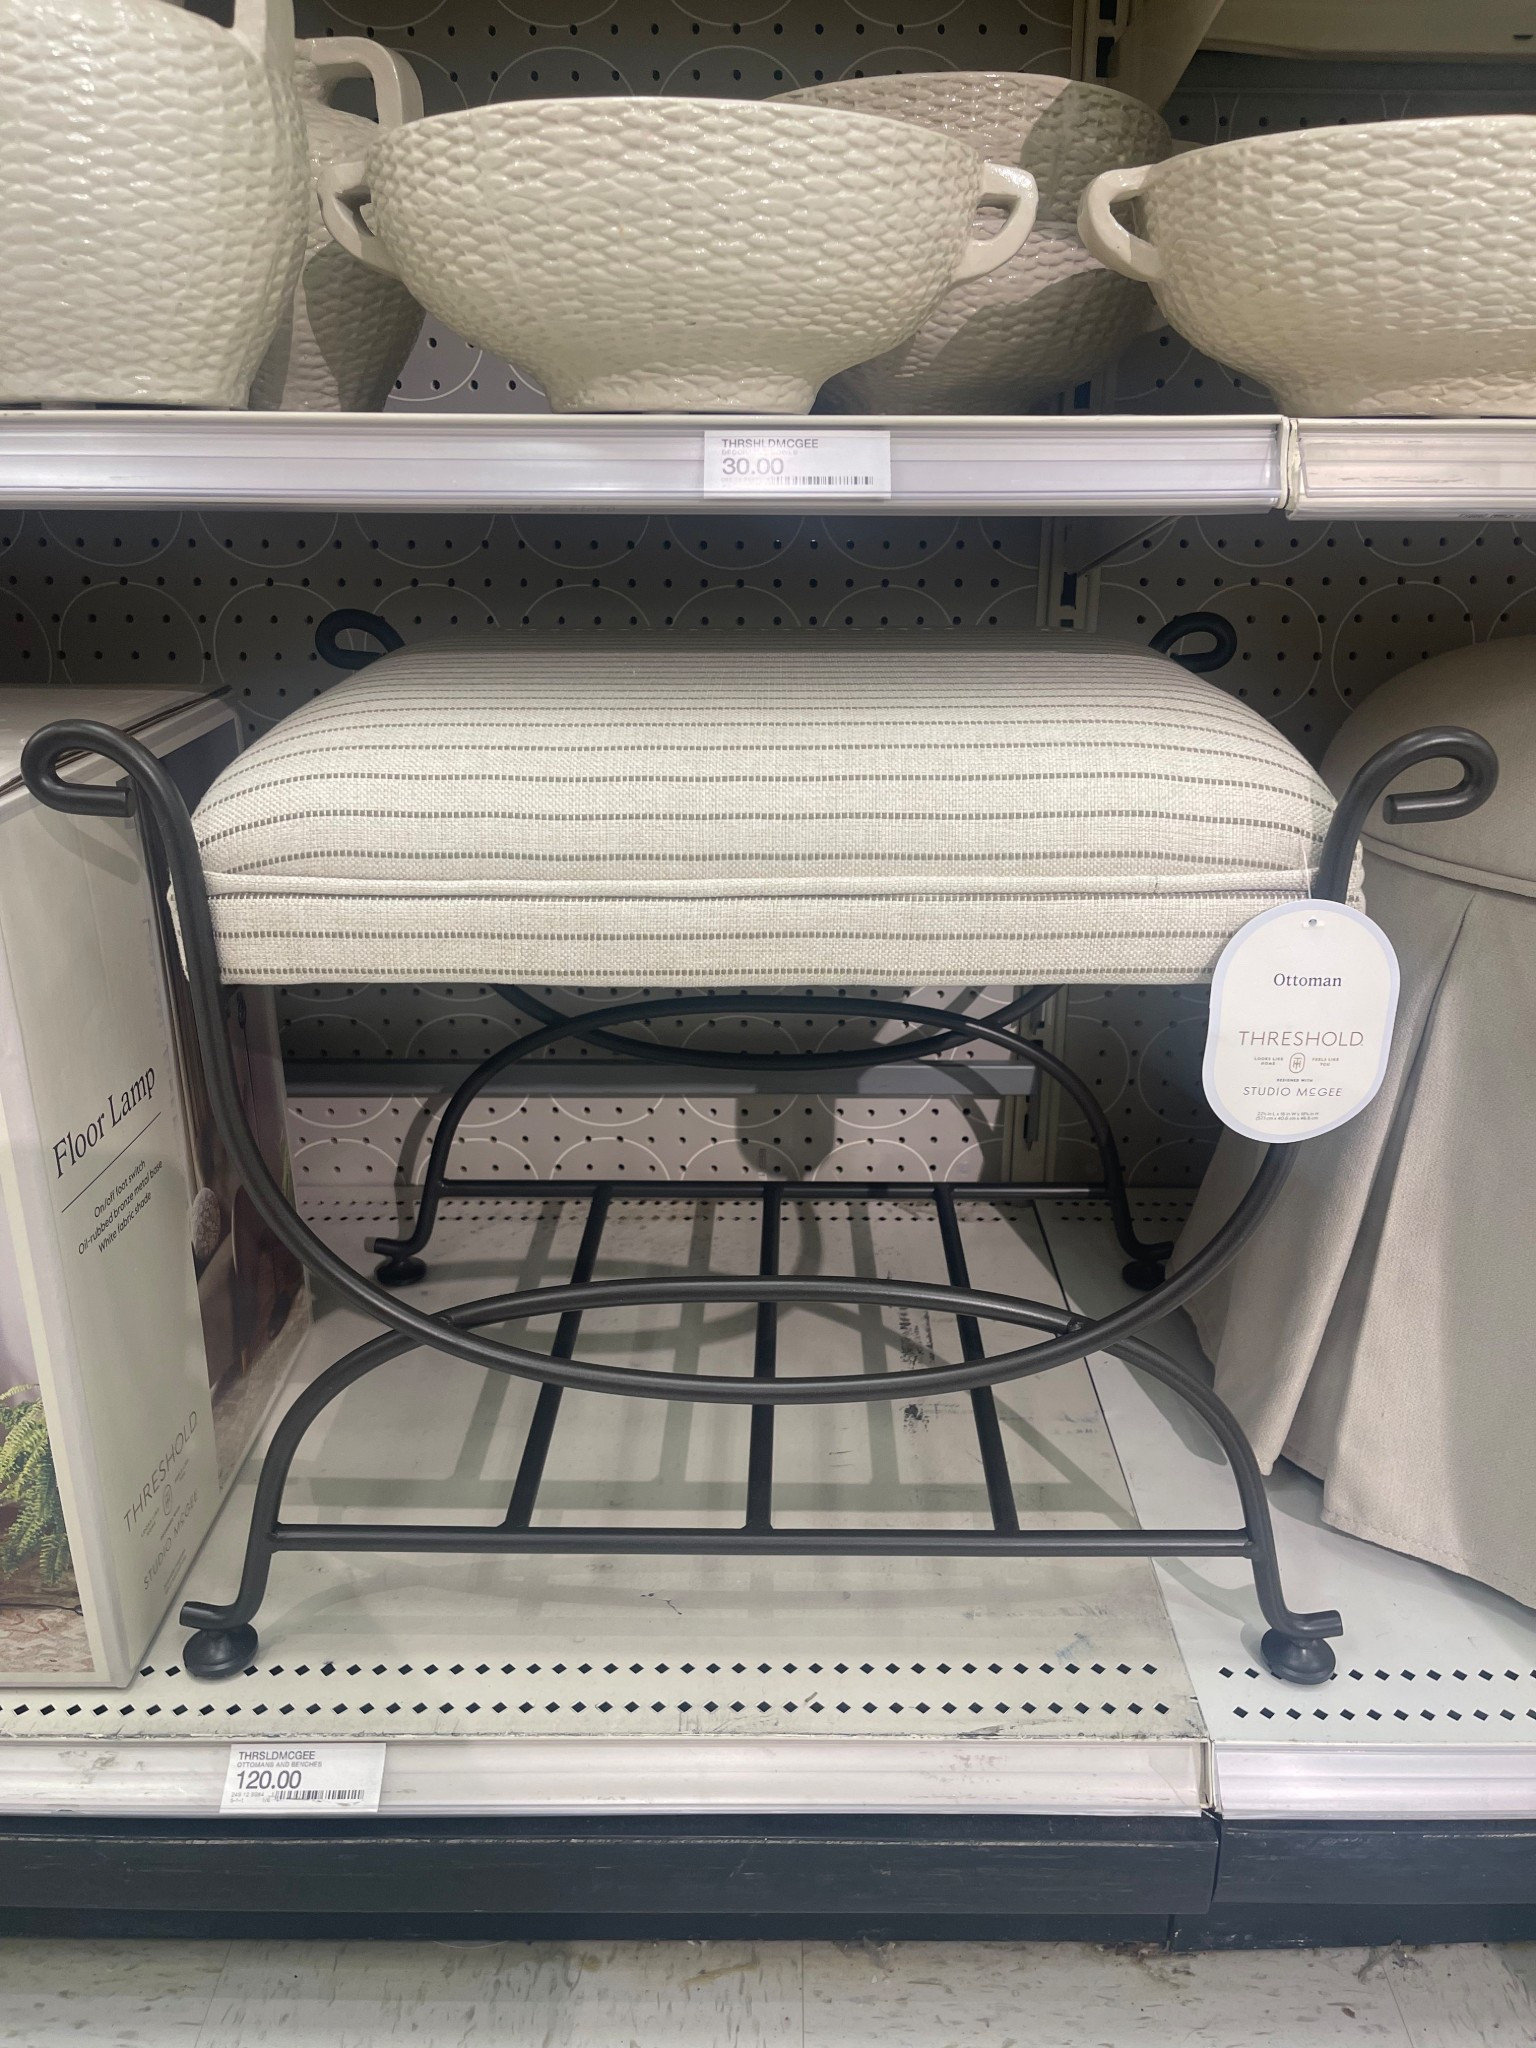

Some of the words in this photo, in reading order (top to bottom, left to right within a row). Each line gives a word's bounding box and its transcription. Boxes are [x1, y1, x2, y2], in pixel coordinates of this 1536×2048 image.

[722, 439, 818, 448] THRSHLDMCGEE
[722, 458, 784, 475] 30.00
[1273, 973, 1342, 987] Ottoman
[1239, 1031, 1364, 1047] THRESHOLD
[1243, 1086, 1291, 1097] STUDIO
[52, 1112, 105, 1179] Floor
[107, 1067, 155, 1128] Lamp
[94, 1190, 116, 1218] On/off
[116, 1178, 128, 1196] foot
[128, 1160, 146, 1183] switch
[78, 1212, 114, 1255] Oil-rubbed
[113, 1192, 134, 1218] bronze
[134, 1172, 149, 1196] metal
[149, 1160, 163, 1179] base
[98, 1230, 117, 1253] White
[117, 1211, 135, 1233] fabric
[135, 1192, 152, 1215] shade
[123, 1411, 198, 1532] THRESHOLD
[144, 1537, 171, 1590] STUDIO
[239, 1751, 316, 1760] THRSLDMCGEE
[236, 1770, 302, 1789] 120.00
